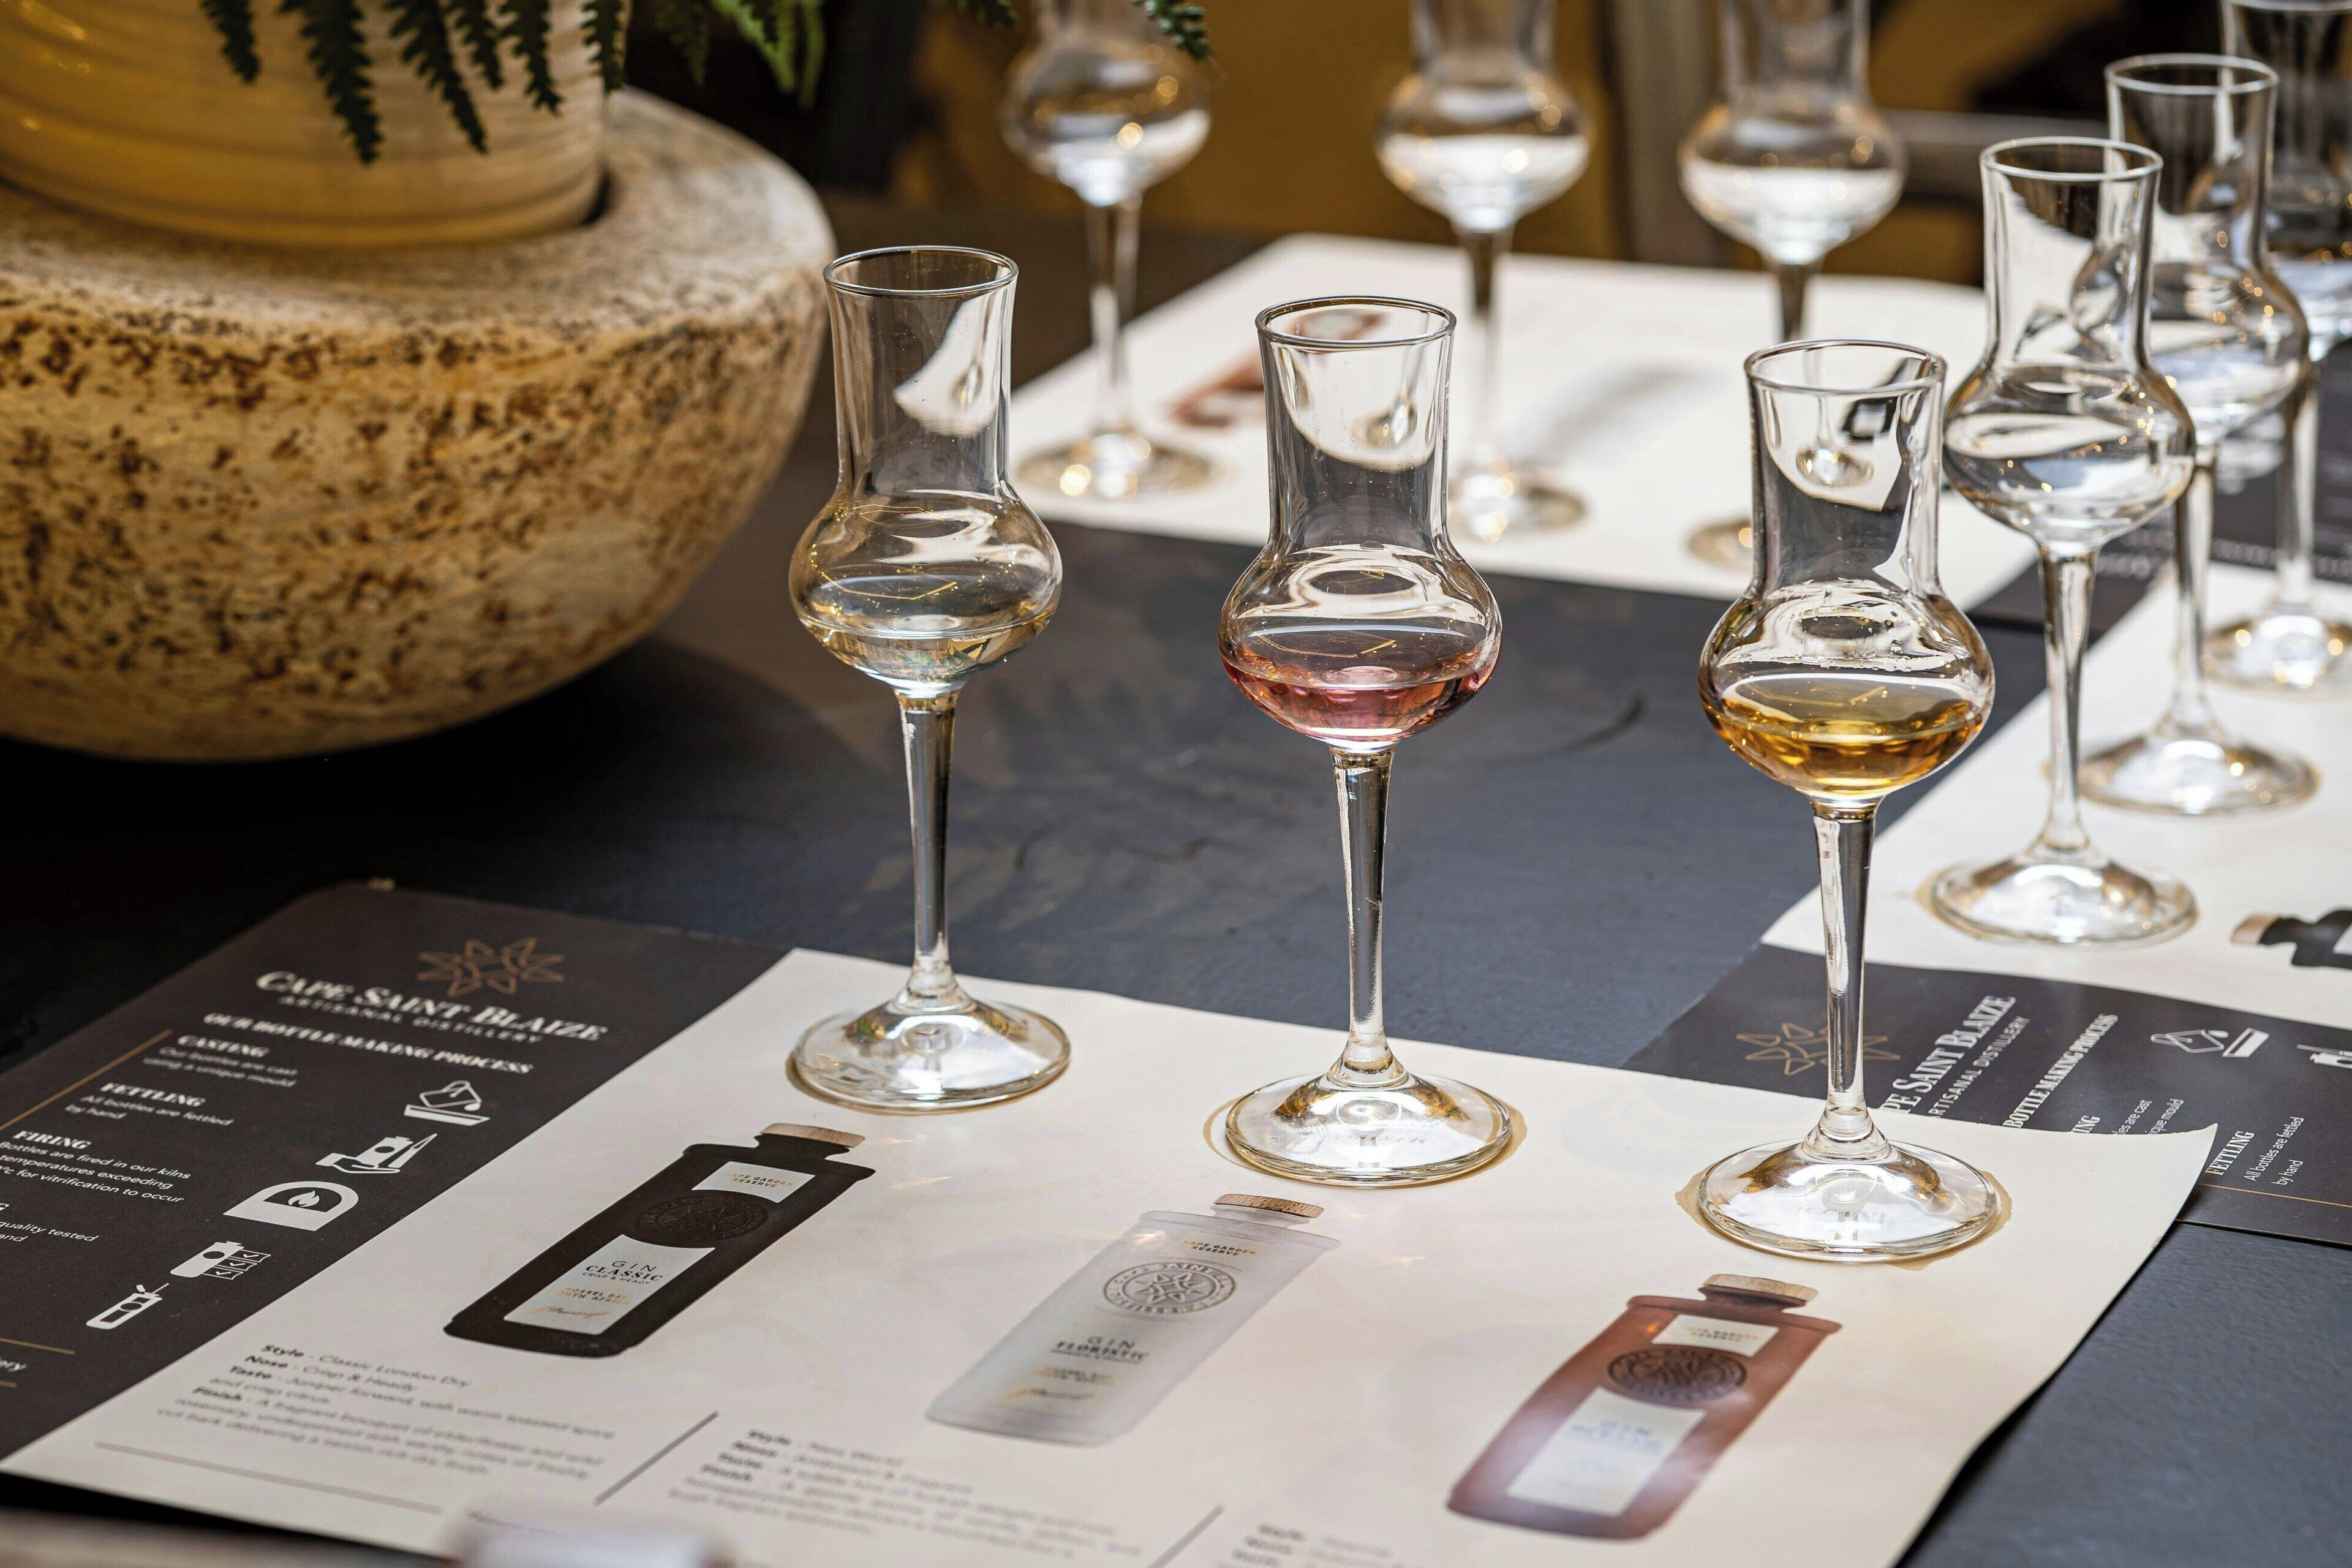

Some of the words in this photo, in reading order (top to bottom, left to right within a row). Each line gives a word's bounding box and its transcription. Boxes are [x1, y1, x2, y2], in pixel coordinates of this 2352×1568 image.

[255, 971, 354, 1001] CAPE
[353, 987, 471, 1019] SAINT
[464, 1005, 609, 1041] BLAIZE
[277, 994, 404, 1024] ARTISANAL
[412, 1016, 544, 1044] DISTILLERY
[1934, 995, 2016, 1049] BLAIZE
[178, 1035, 270, 1058] CASTING
[203, 1012, 254, 1030] OUR
[251, 1020, 341, 1045] BOTTLE
[337, 1035, 434, 1059] MAKING
[427, 1050, 534, 1074] PROCESS
[188, 1052, 240, 1067] bottles
[239, 1061, 266, 1071] are
[1892, 1047, 1965, 1094] SAINT
[1928, 1069, 1983, 1118] RTISANAL
[1972, 1016, 2030, 1068] DISTILLERY
[99, 1082, 207, 1107] FETTLING
[2001, 1089, 2051, 1128] BOTTLE
[2034, 1050, 2085, 1092] MAKING
[64, 1104, 87, 1115] by
[85, 1107, 127, 1120] hand
[80, 1095, 106, 1104] All
[103, 1098, 156, 1114] bottles
[155, 1108, 181, 1117] are
[182, 1111, 235, 1127] fettled
[1879, 1093, 1922, 1114] PE
[2125, 1113, 2141, 1126] are
[2276, 1116, 2305, 1139] fettled
[12, 1130, 92, 1150] FIRING
[2272, 1138, 2288, 1150] are
[2204, 1131, 2255, 1176] FETTLING
[2249, 1149, 2280, 1172] bottles
[0, 1155, 96, 1176] temperatures
[97, 1170, 174, 1190] exceeding
[49, 1150, 75, 1160] are
[76, 1154, 115, 1166] fired
[112, 1159, 128, 1169] in
[129, 1163, 158, 1173] our
[157, 1167, 192, 1180] kilns
[2278, 1159, 2304, 1177] hand
[732, 1178, 778, 1188] RESERVE
[753, 1177, 794, 1186] GARDEN
[2243, 1170, 2263, 1182] All
[2271, 1176, 2294, 1186] by
[16, 1169, 39, 1178] for
[40, 1174, 120, 1194] vitrification
[141, 1192, 185, 1204] occur
[48, 1229, 100, 1242] tested
[1191, 1246, 1240, 1256] RESERVE
[1213, 1245, 1256, 1256] GARDEN
[585, 1265, 664, 1282] CLASSIC
[612, 1261, 657, 1272] GIN
[260, 1344, 304, 1358] Style
[1088, 1335, 1137, 1349] GIN
[244, 1355, 288, 1368] Nose
[229, 1365, 272, 1379] Taste
